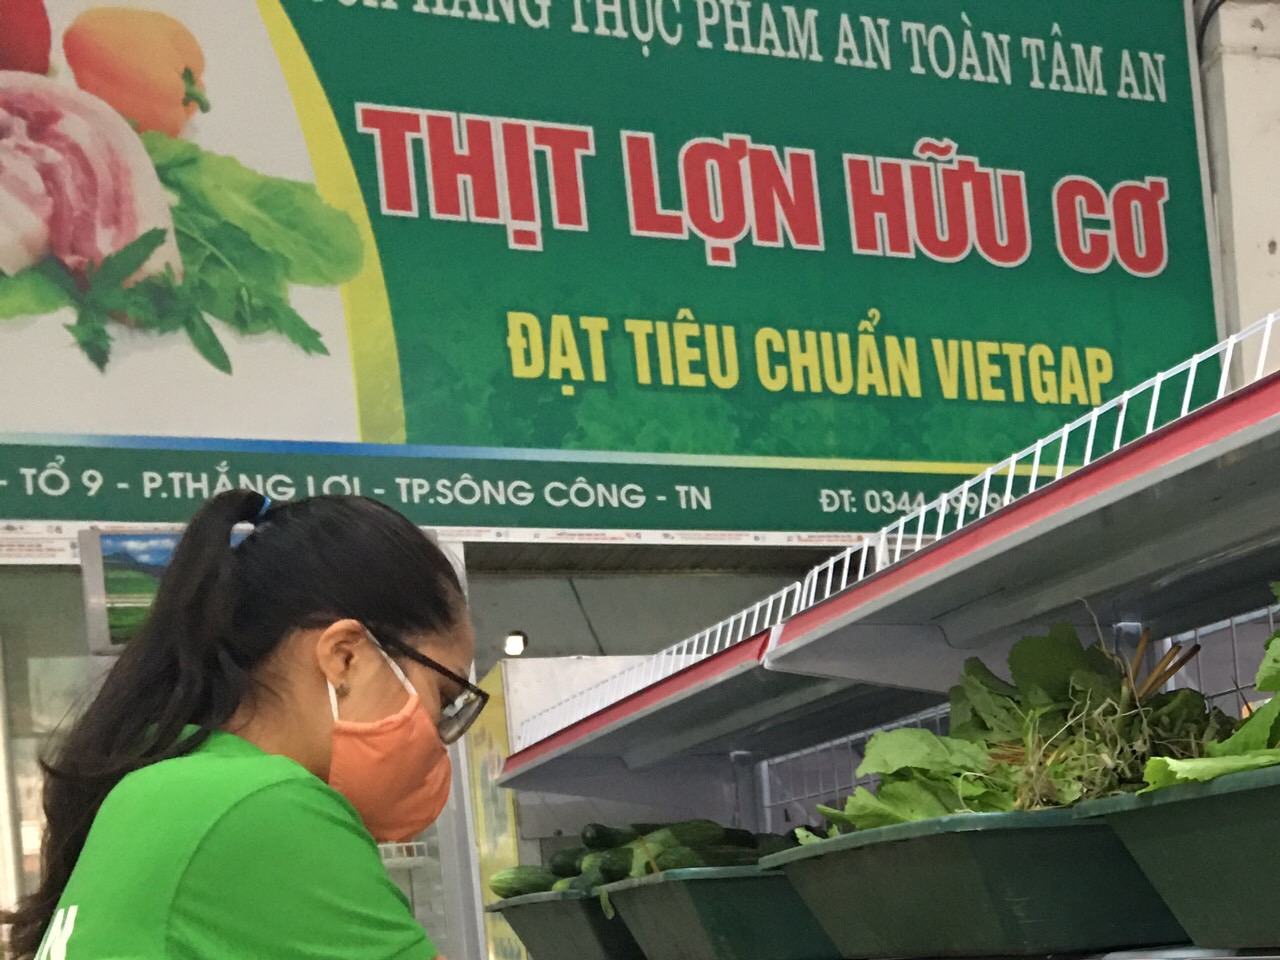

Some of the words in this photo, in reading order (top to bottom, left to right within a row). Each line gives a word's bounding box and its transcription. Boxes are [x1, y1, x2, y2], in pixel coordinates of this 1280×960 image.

[834, 13, 892, 71] AN
[902, 11, 1012, 85] TOÀN
[1022, 22, 1107, 96] TÂM
[1117, 49, 1168, 102] AN
[354, 102, 596, 251] THỊT
[620, 129, 825, 268] LỢN
[842, 137, 1032, 268] HỮU
[1052, 175, 1169, 278] CƠ
[506, 311, 608, 397] ĐẠT
[625, 308, 739, 390] TIÊU
[754, 308, 922, 398] CHUẨN
[932, 338, 1114, 406] VIETGAP
[19, 454, 70, 497] TỔ
[81, 469, 104, 497] 9
[142, 460, 296, 501] P.THẮNG
[395, 473, 535, 506] TP.SÔNG
[544, 476, 646, 508] CÔNG
[675, 485, 712, 510] TN
[819, 489, 856, 513] ĐT:
